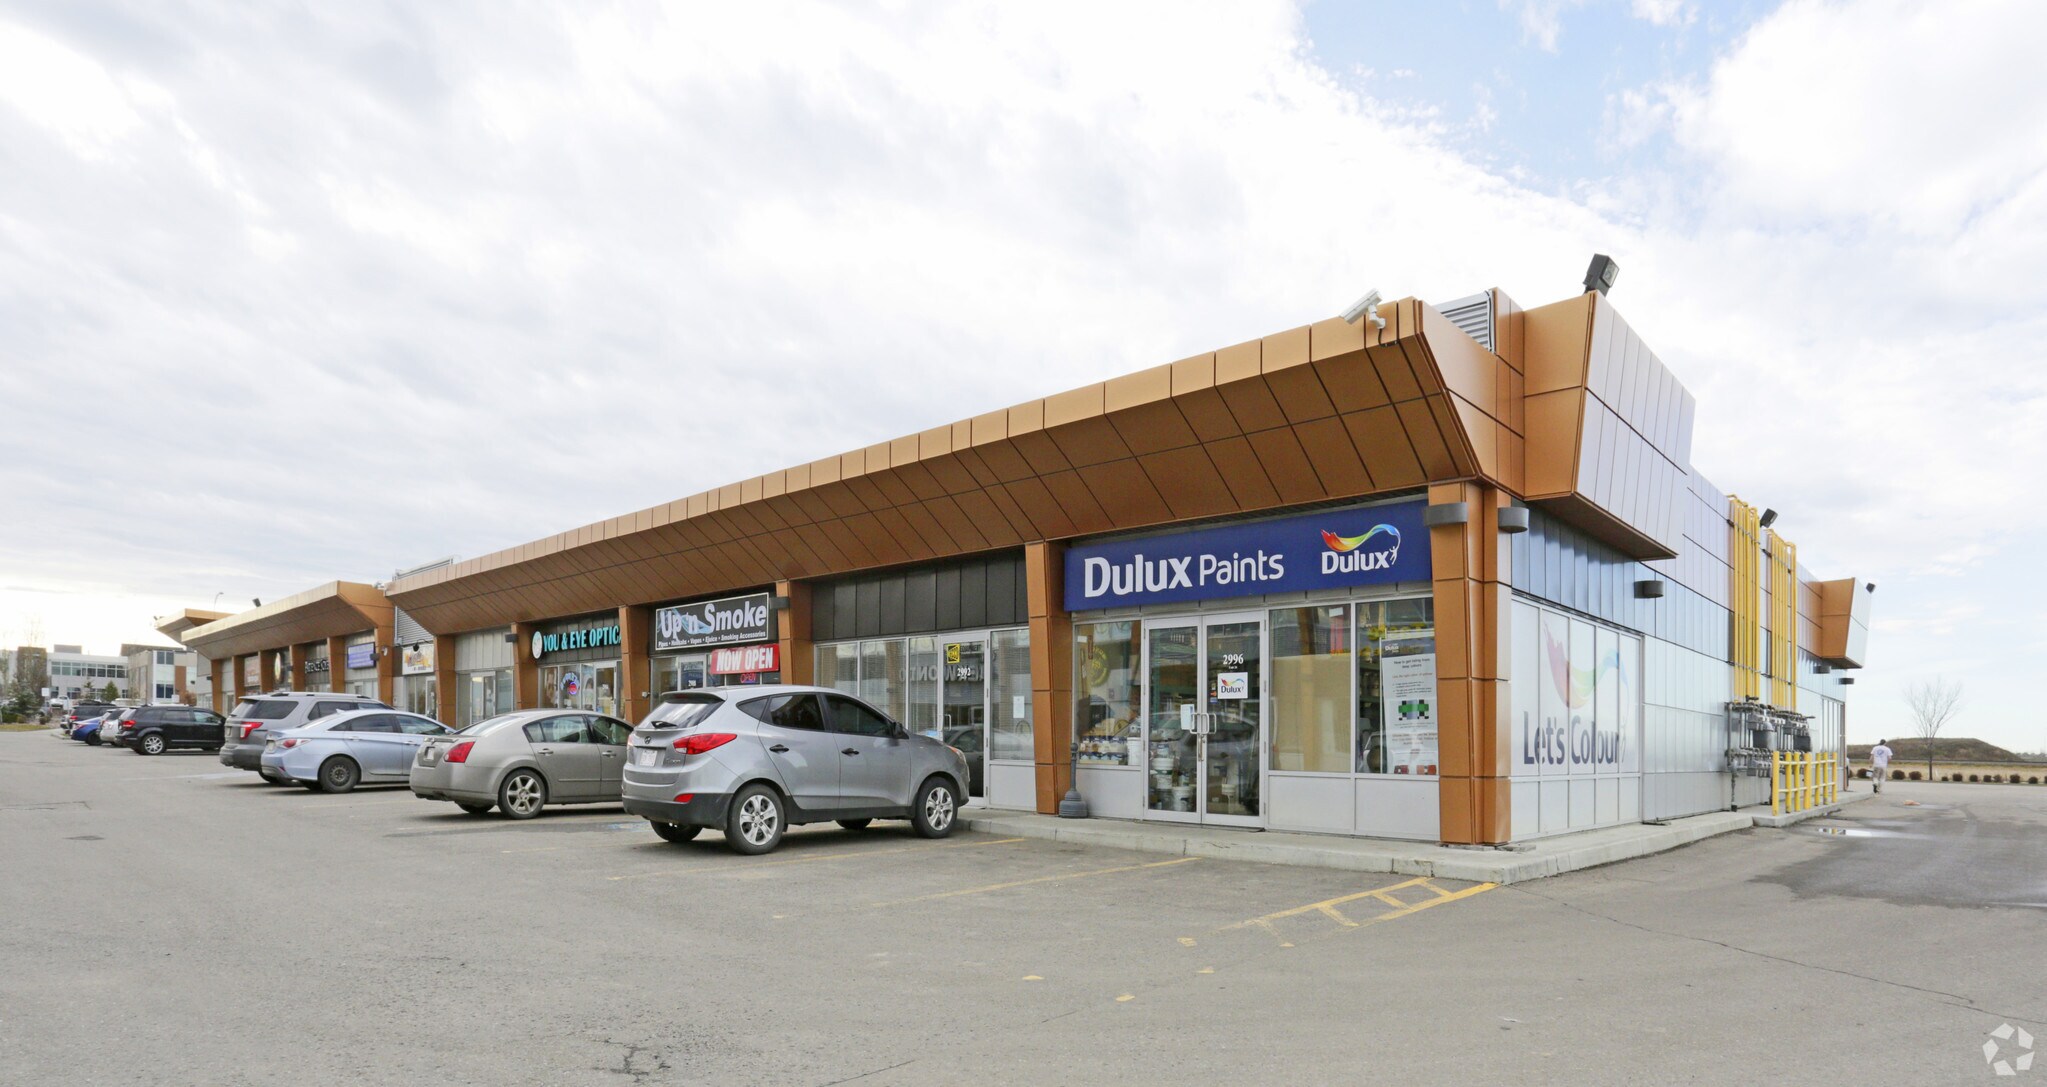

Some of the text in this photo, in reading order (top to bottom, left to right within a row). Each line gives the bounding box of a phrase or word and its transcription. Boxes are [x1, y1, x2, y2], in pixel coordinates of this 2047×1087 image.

[1321, 549, 1390, 574] Dulux
[1084, 550, 1284, 598] Dulux Paints
[660, 610, 683, 640] Up
[704, 601, 767, 634] Smoke
[543, 633, 560, 652] YOU
[561, 632, 568, 650] &
[569, 629, 587, 649] EYE
[720, 634, 739, 642] Smoking
[739, 631, 766, 639] Accessories
[716, 647, 774, 672] NOW OPEN
[1222, 653, 1244, 665] 2996
[740, 673, 756, 683] OPEN
[957, 667, 971, 677] 2992
[1220, 685, 1242, 693] Dulux
[1523, 710, 1620, 765] Let's Colour
